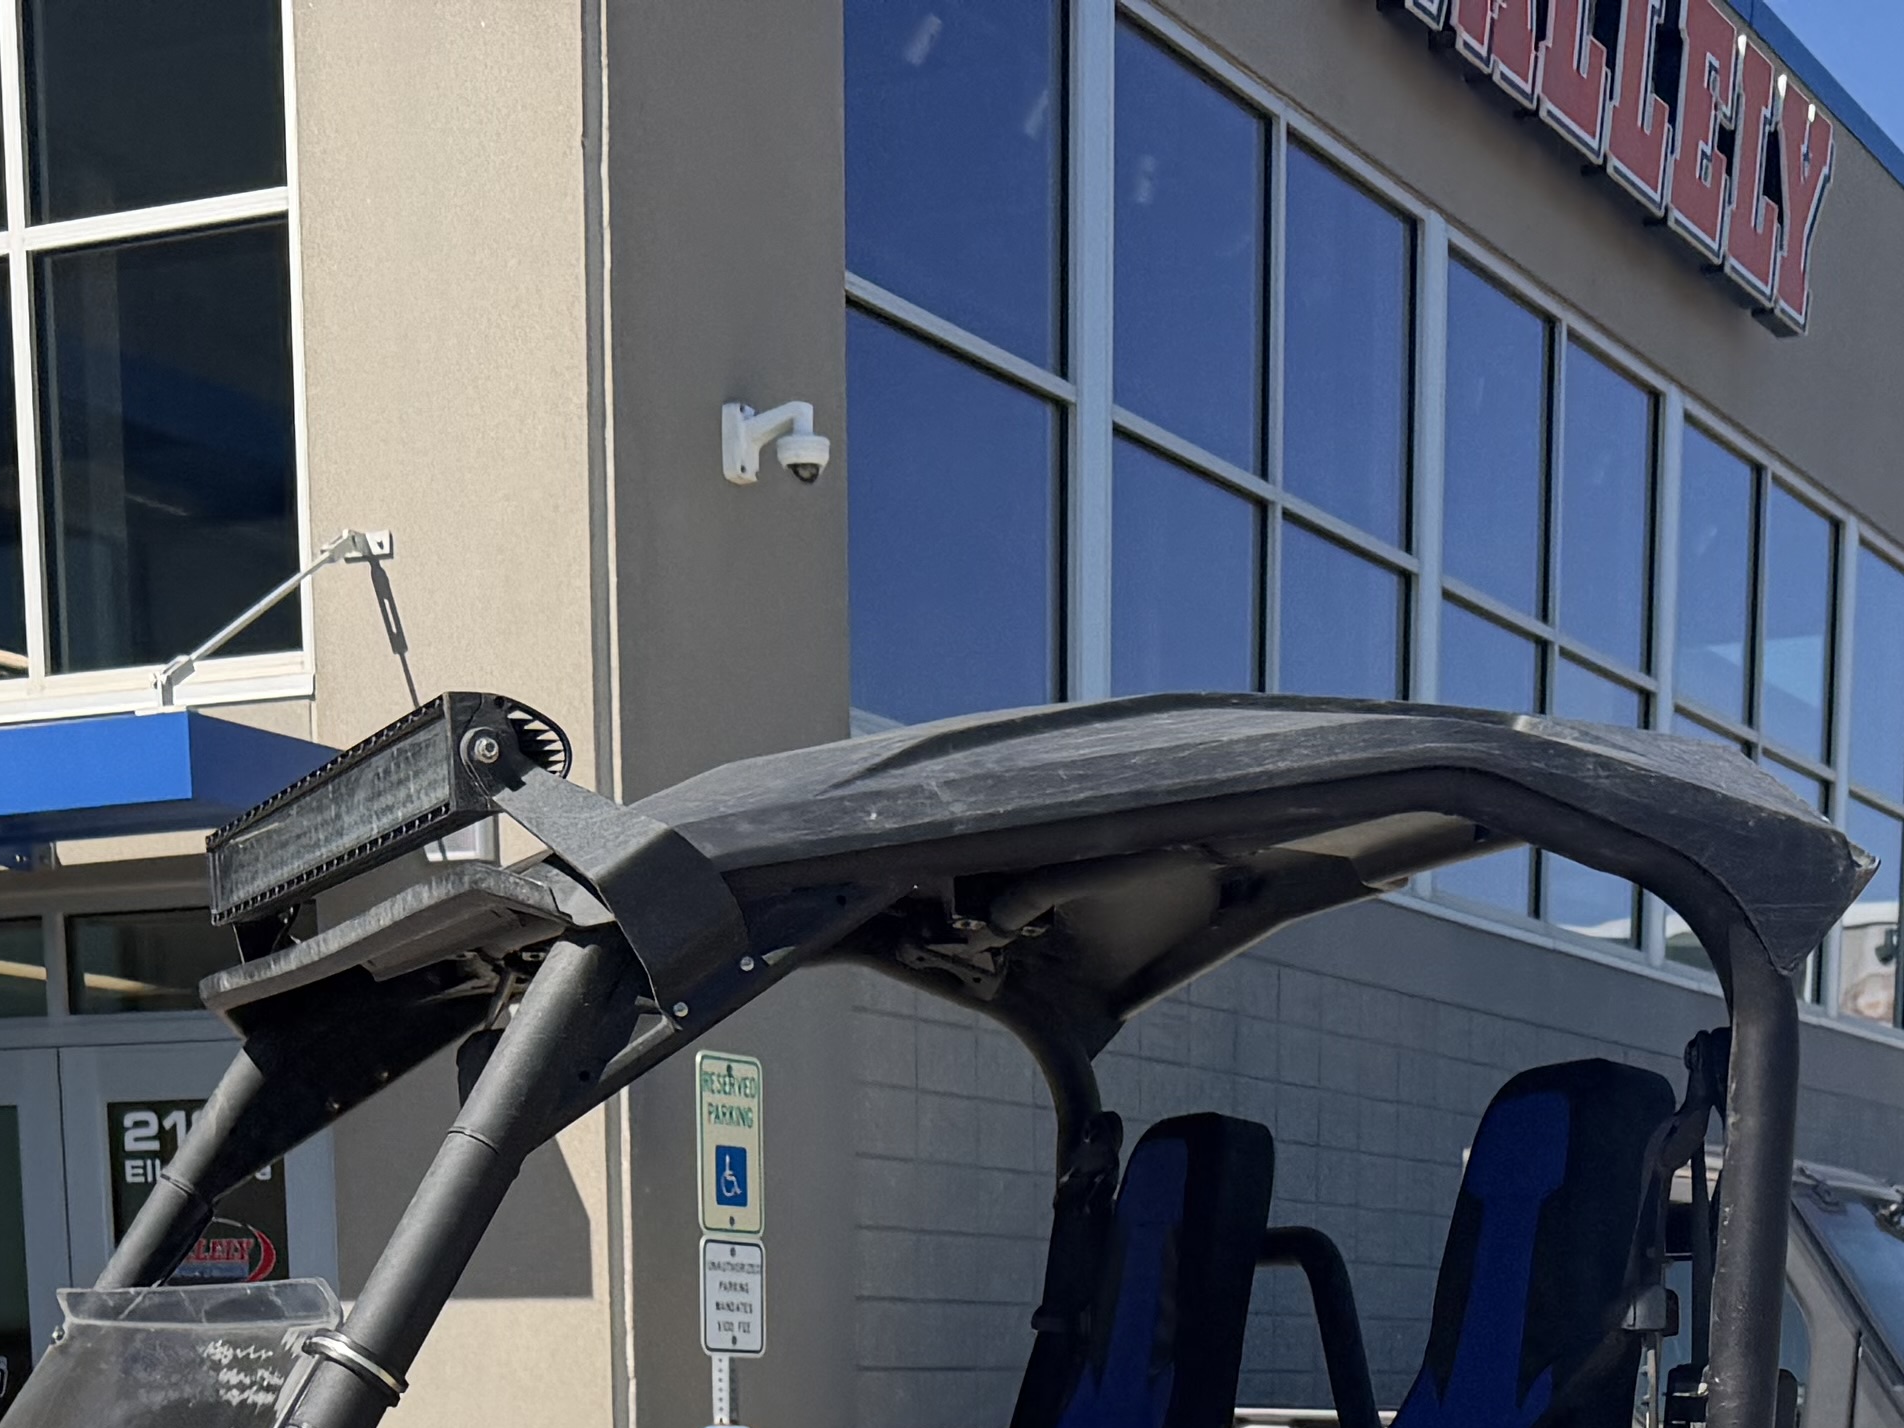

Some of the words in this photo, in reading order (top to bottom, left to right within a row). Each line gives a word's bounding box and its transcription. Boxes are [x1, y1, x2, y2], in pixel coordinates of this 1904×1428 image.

[1404, 0, 1836, 335] LLELY
[702, 1071, 757, 1100] RESERVED
[707, 1102, 754, 1130] PARKING
